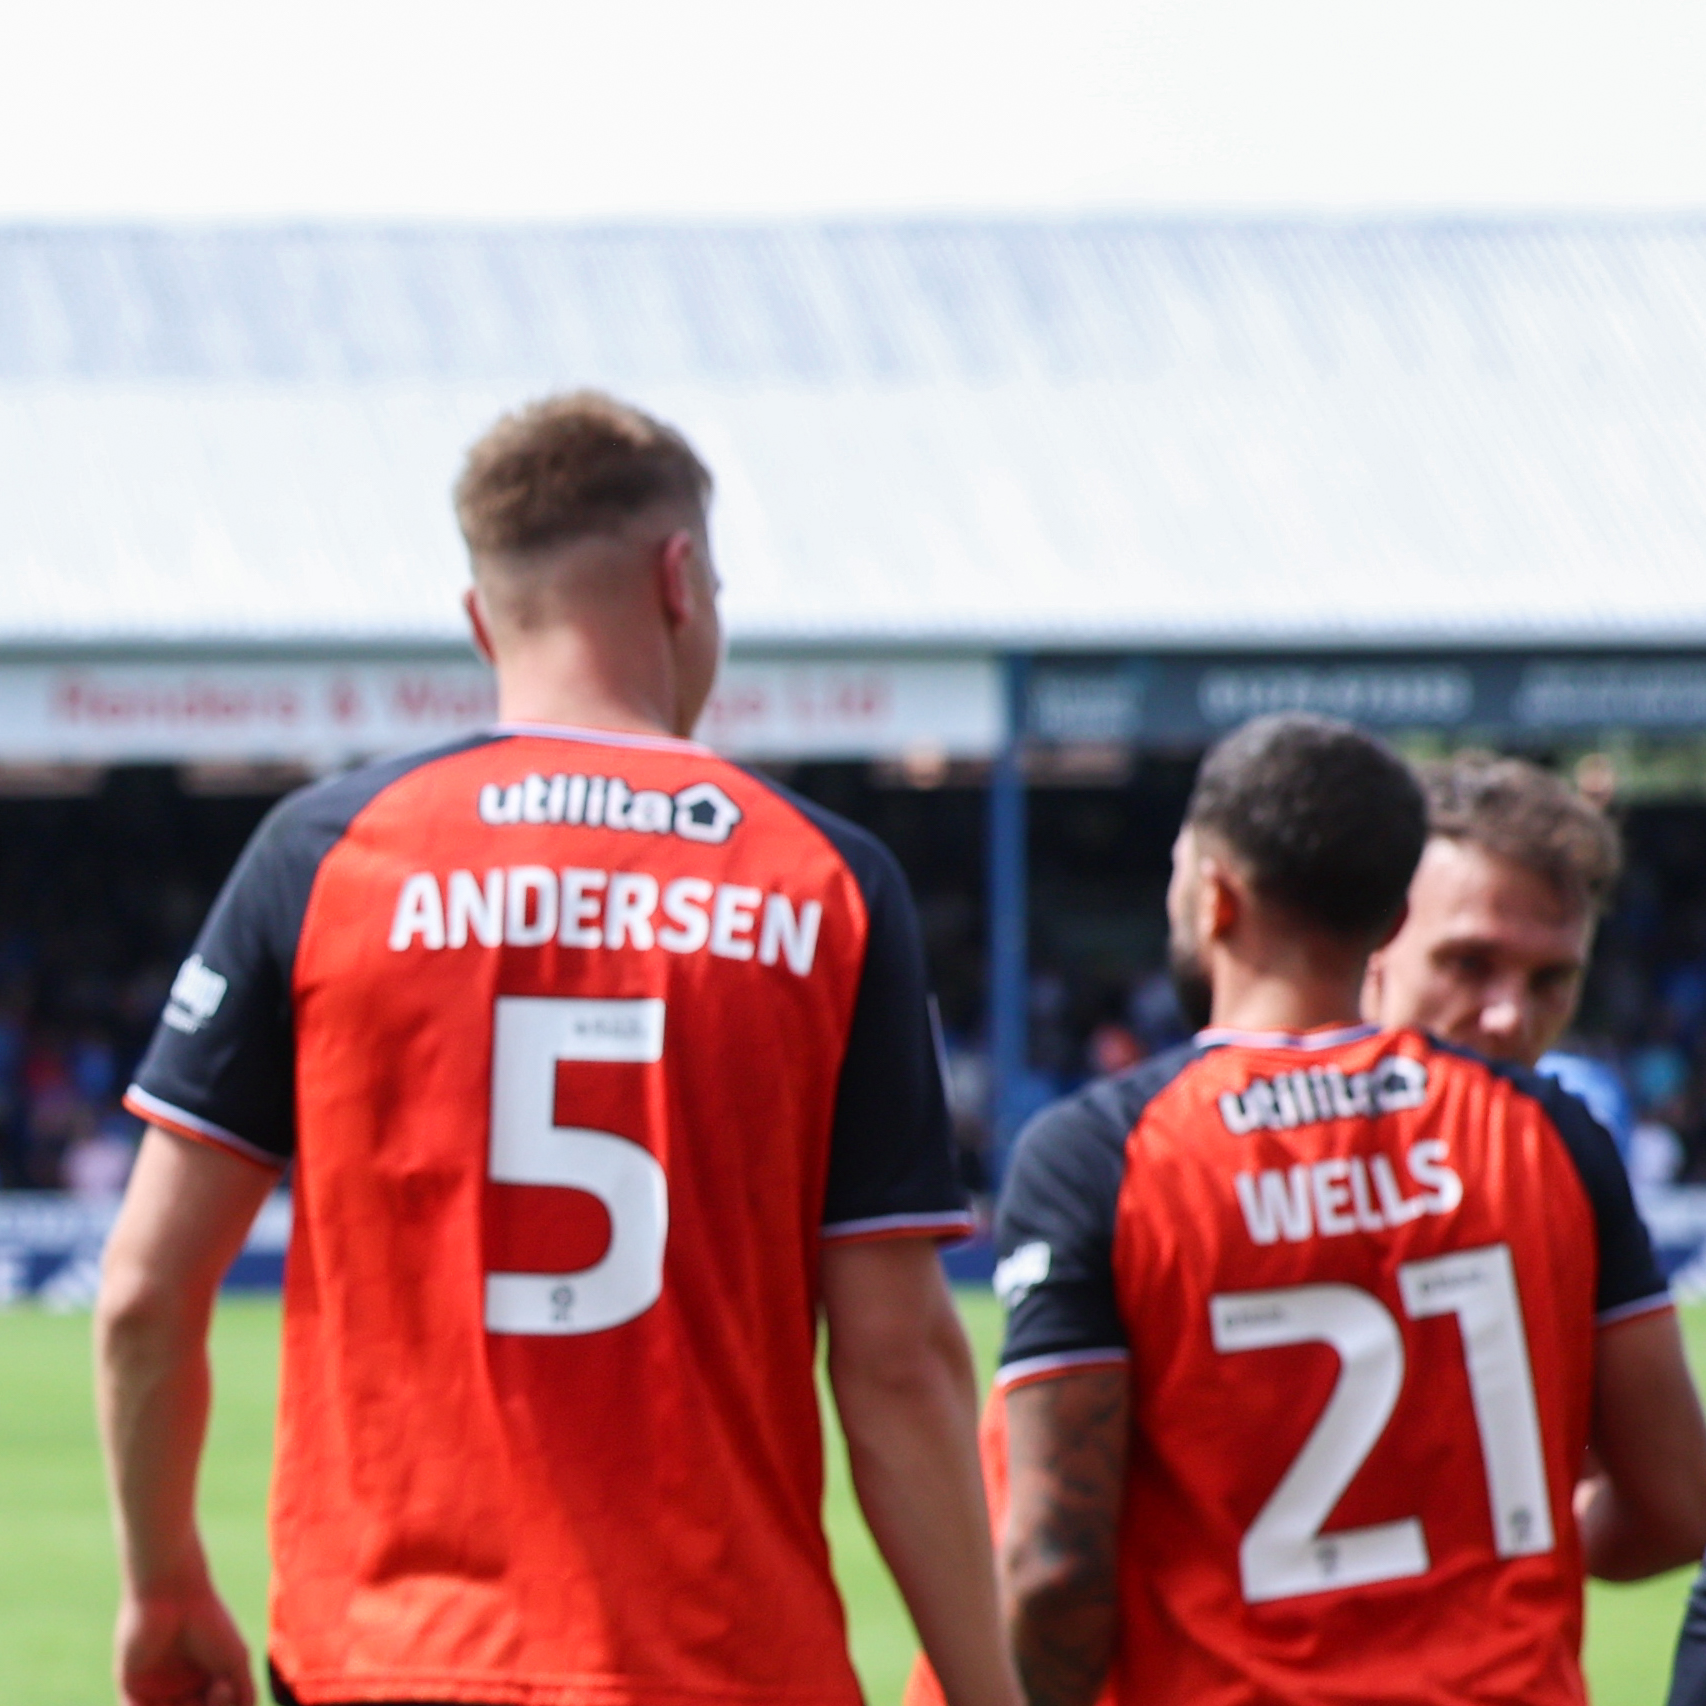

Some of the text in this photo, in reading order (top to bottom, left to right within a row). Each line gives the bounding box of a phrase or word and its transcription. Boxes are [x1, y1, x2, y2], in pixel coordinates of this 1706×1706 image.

[478, 774, 674, 836] utilita
[389, 865, 824, 977] ANDERSEN
[483, 995, 670, 1337] 5
[1233, 1138, 1464, 1246] WELLS
[1208, 1242, 1556, 1605] 21
